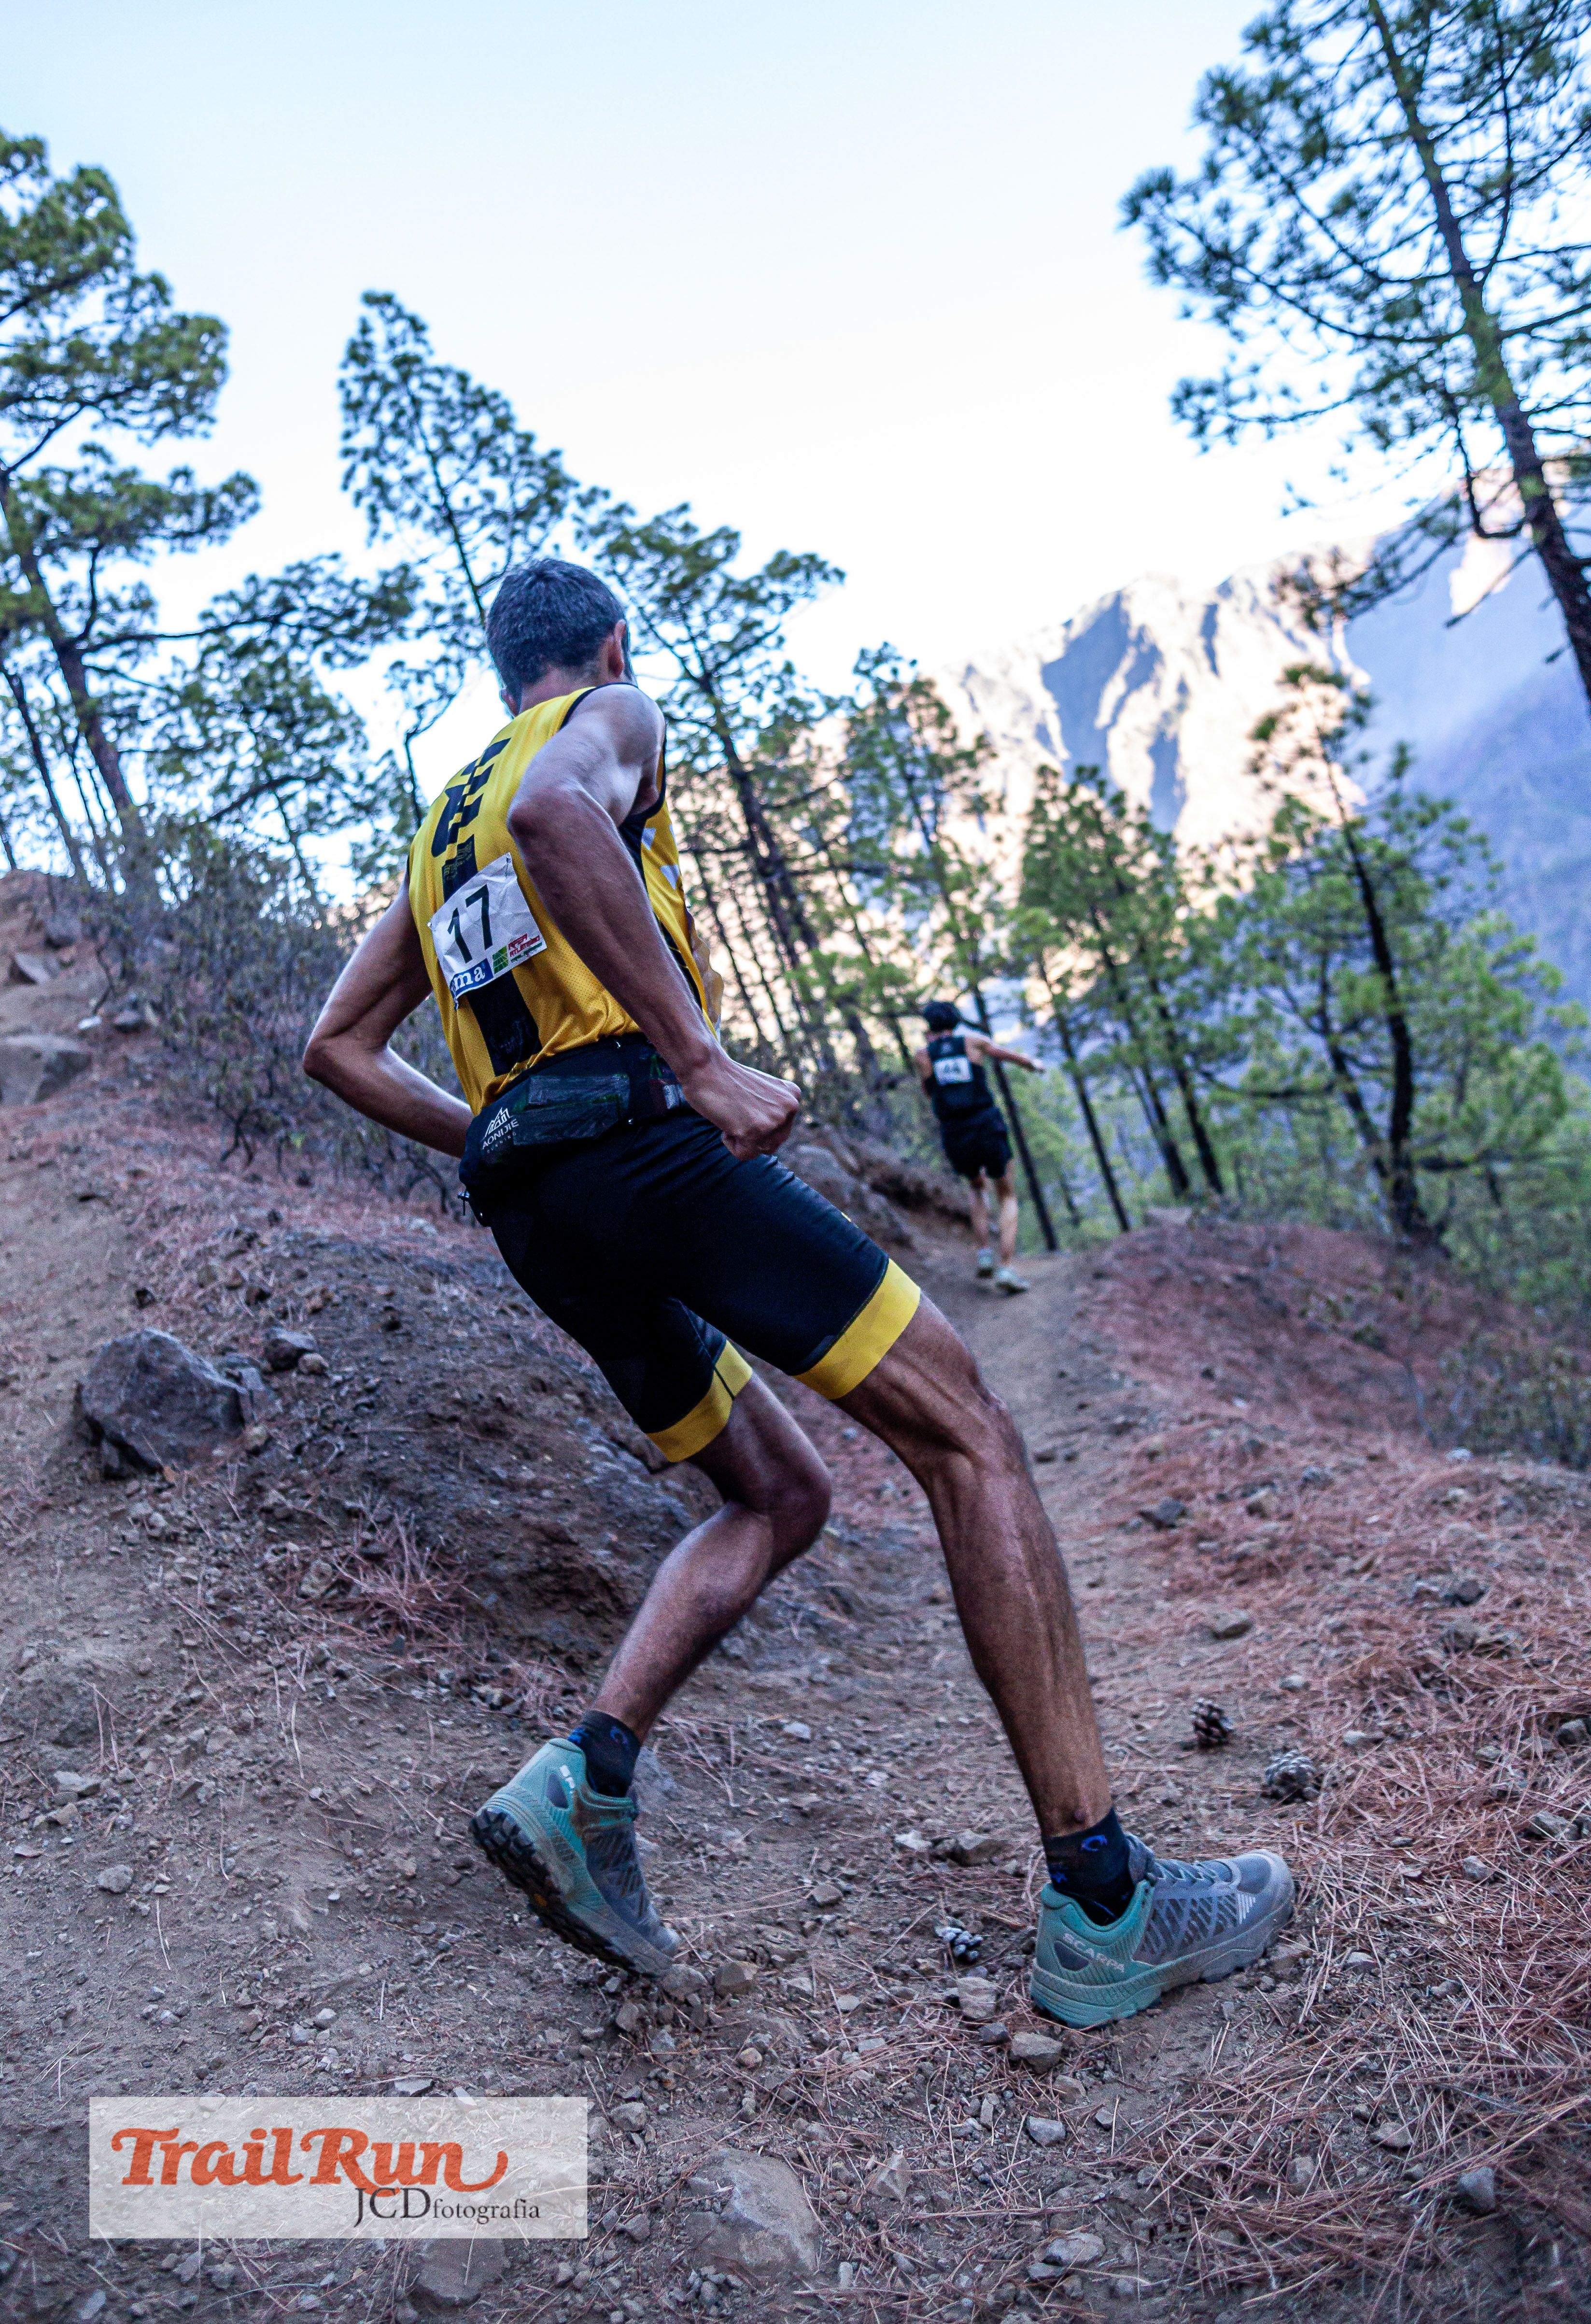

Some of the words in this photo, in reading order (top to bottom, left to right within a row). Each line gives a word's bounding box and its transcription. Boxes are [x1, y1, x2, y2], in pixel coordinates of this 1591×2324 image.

[449, 884, 493, 964] 17
[451, 966, 485, 990] ma
[483, 1118, 519, 1149] AONIJIE
